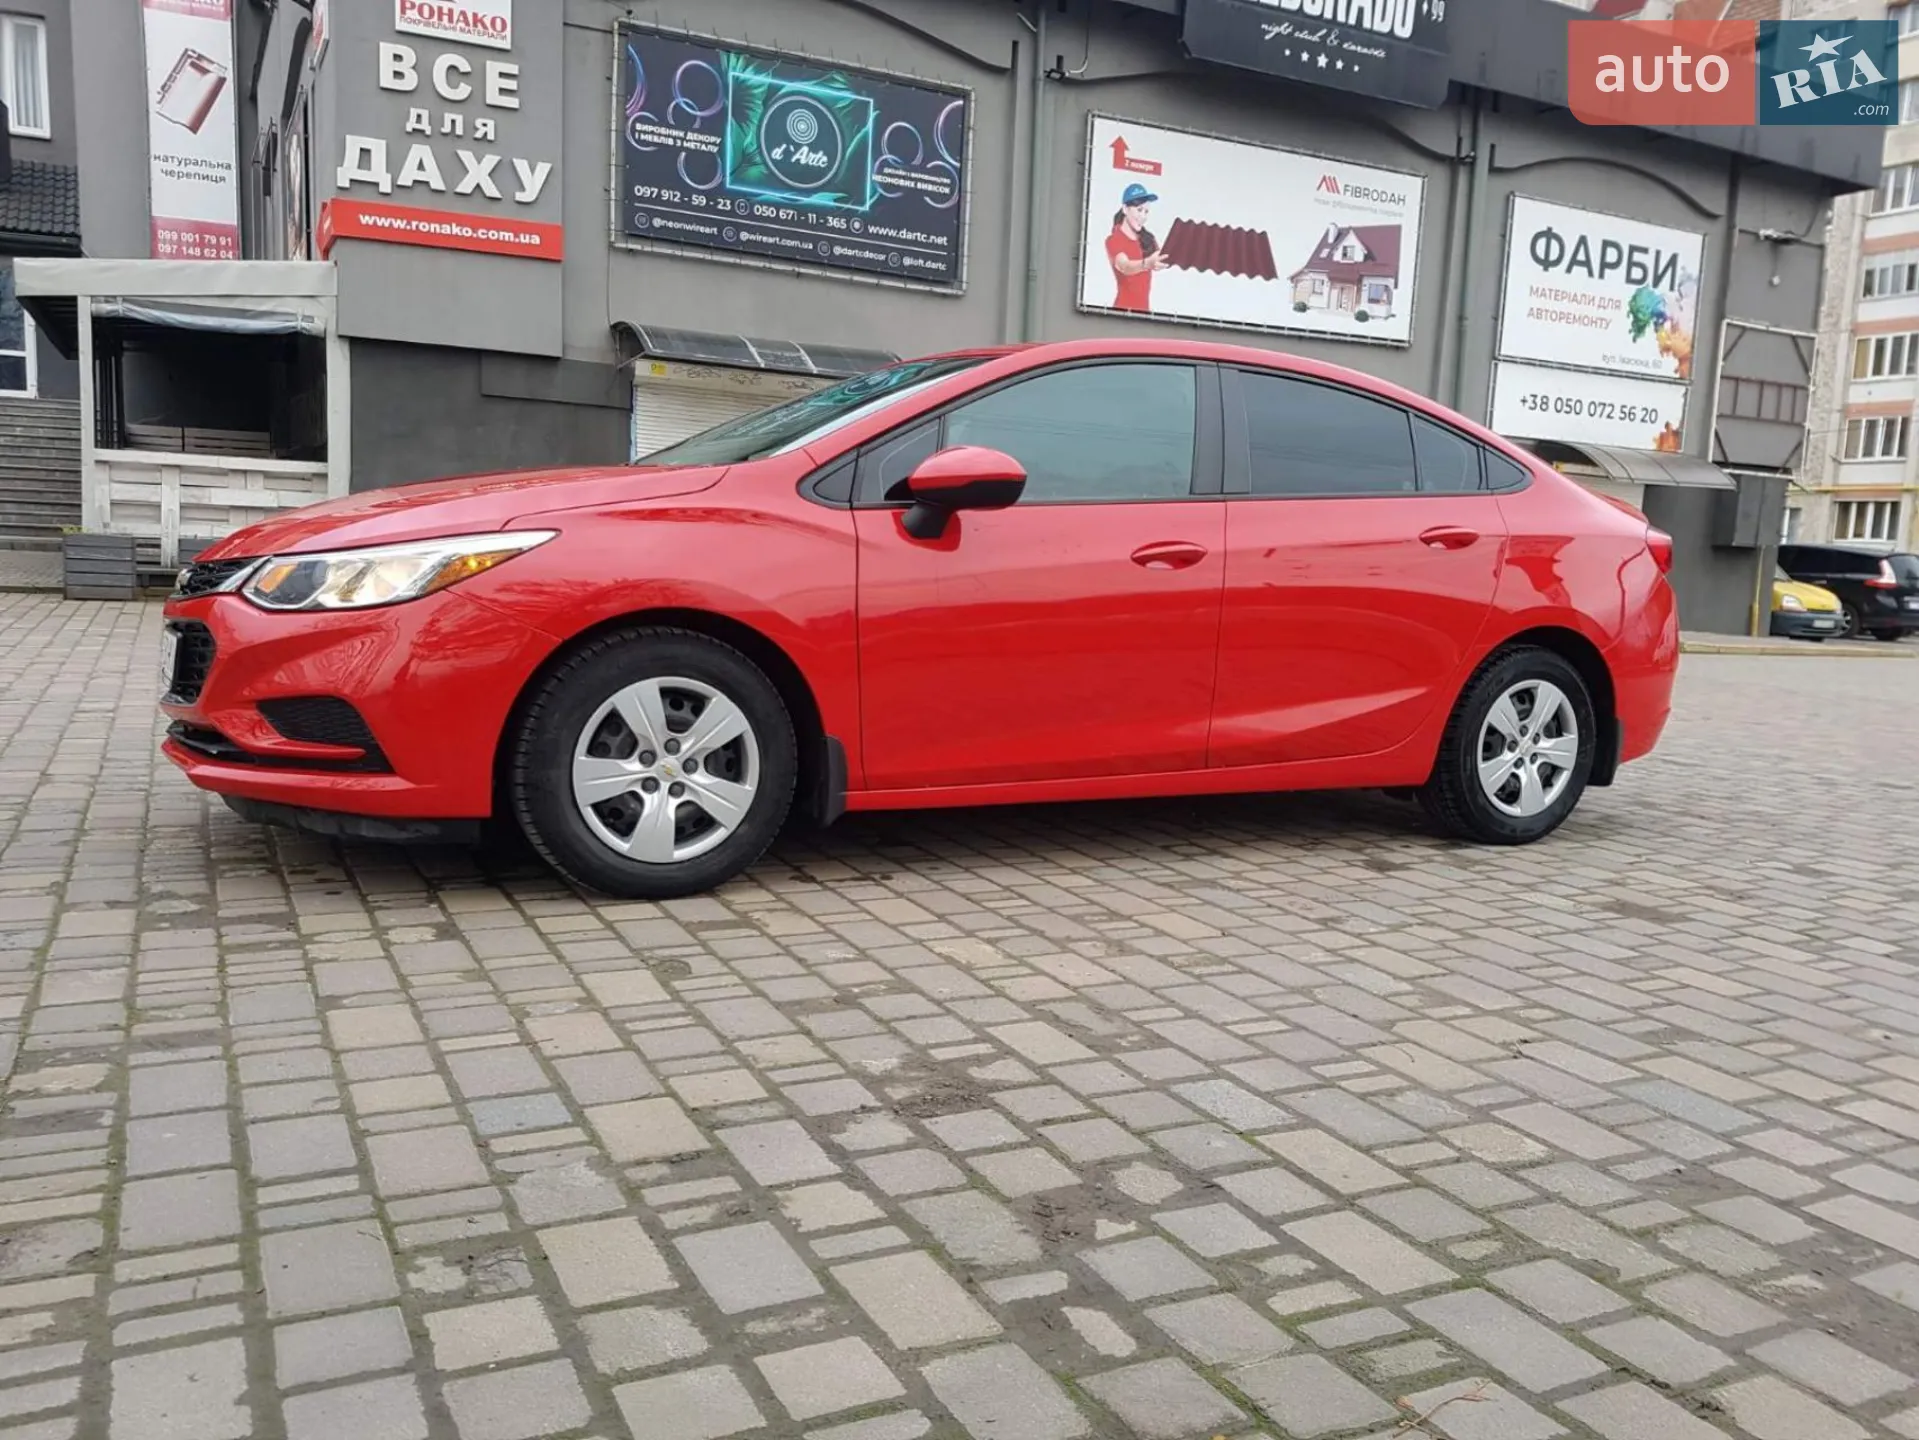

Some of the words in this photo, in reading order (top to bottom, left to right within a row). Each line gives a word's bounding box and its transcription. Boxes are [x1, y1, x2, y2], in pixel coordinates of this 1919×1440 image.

[400, 0, 507, 33] РОНАКО
[379, 42, 519, 109] ВСЕ
[153, 154, 232, 170] натуральна
[337, 134, 552, 203] ДАХУ
[160, 168, 226, 184] черепиця
[634, 185, 658, 198] 097
[661, 190, 681, 202] 912
[692, 194, 706, 207] 59
[717, 199, 731, 210] 23
[1343, 184, 1406, 206] FIBRODAH
[359, 213, 541, 245] www.ronako.com.ua
[753, 204, 776, 218] 050
[779, 208, 797, 221] 671
[808, 213, 816, 224] 11
[827, 216, 847, 229] 365
[158, 229, 178, 240] 099
[181, 232, 199, 242] 001
[739, 231, 813, 249] @wireart.com.ua
[158, 243, 178, 254] 097
[1530, 226, 1679, 292] ФАРБИ
[1529, 285, 1595, 307] МАТЕРІАЛИ
[1597, 297, 1622, 310] ДЛЯ
[1527, 307, 1612, 330] АВТОРЕМОНТУ
[1520, 394, 1549, 412] +38
[1554, 396, 1583, 415] 050
[1587, 401, 1615, 419] 072
[1618, 404, 1636, 422] 56
[1640, 407, 1658, 424] 20
